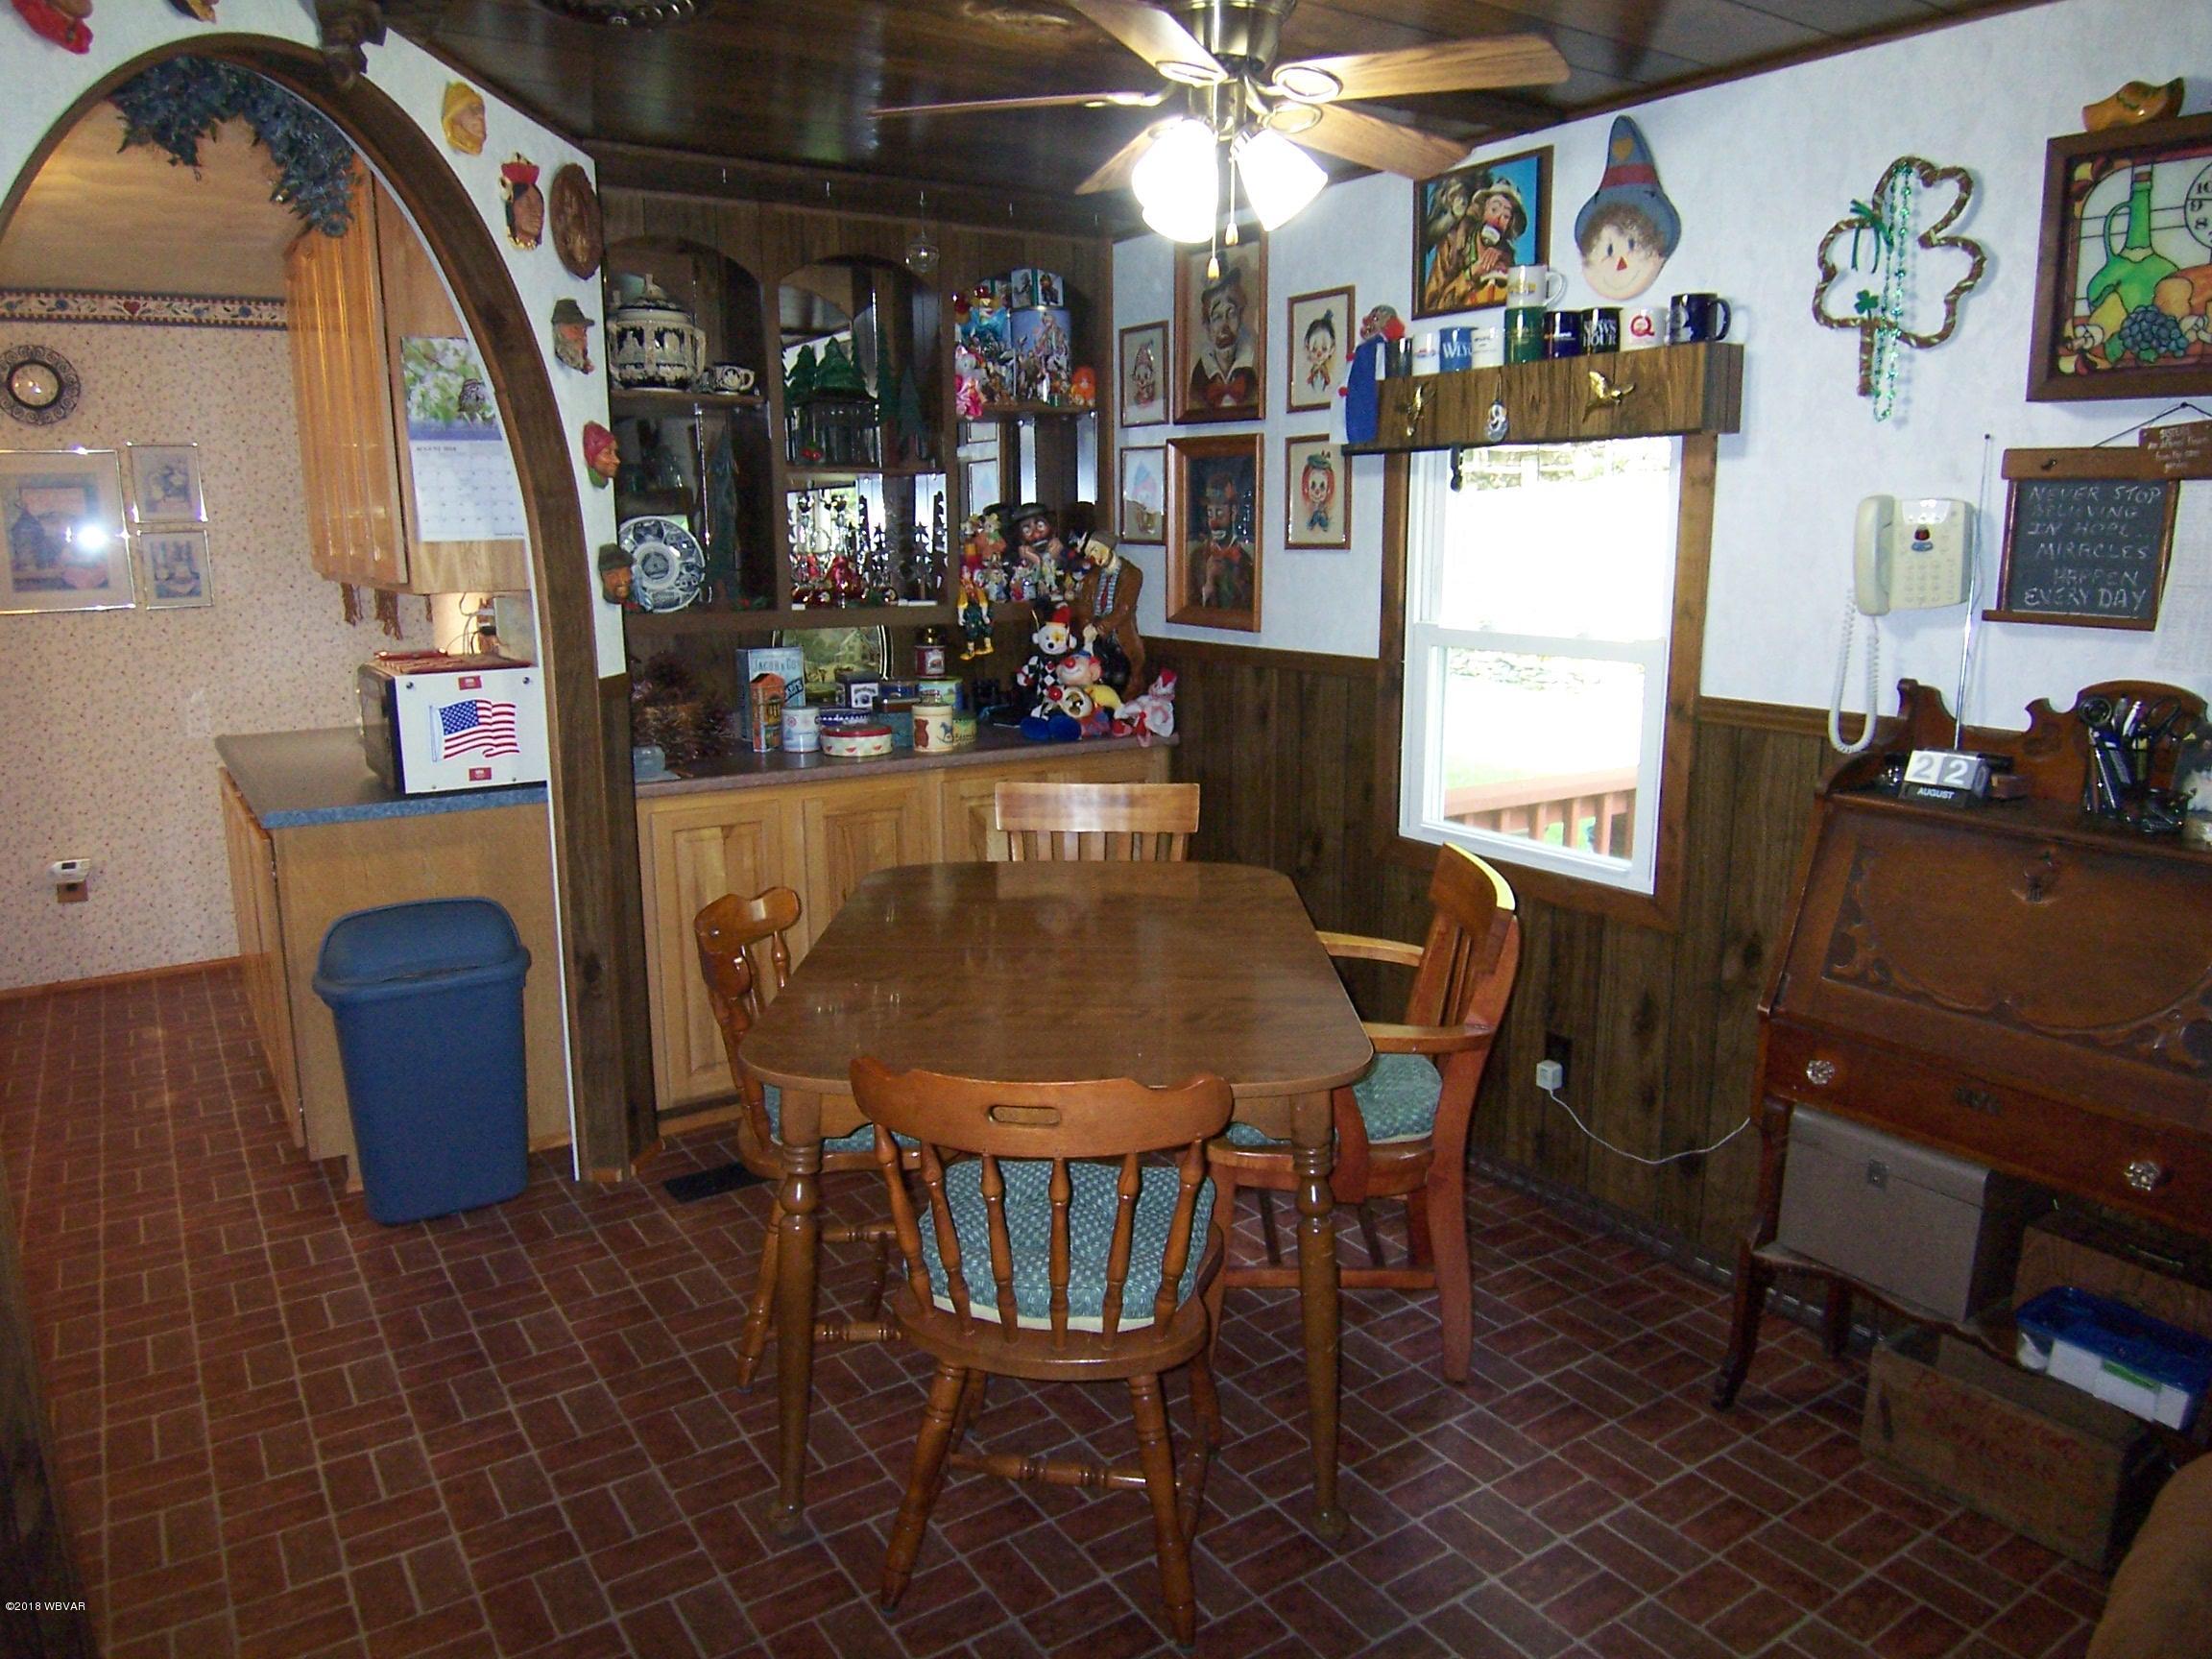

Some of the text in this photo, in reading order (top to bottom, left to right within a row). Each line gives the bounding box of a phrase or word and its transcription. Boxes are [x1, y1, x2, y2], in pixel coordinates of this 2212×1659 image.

[2029, 485, 2162, 504] NEVER STOP
[2028, 522, 2062, 536] IN
[2035, 541, 2151, 561] MIRACLES
[2053, 568, 2139, 587] HAPPEN
[2024, 587, 2147, 612] EVERY DAY
[1916, 787, 1955, 799] AUGUST
